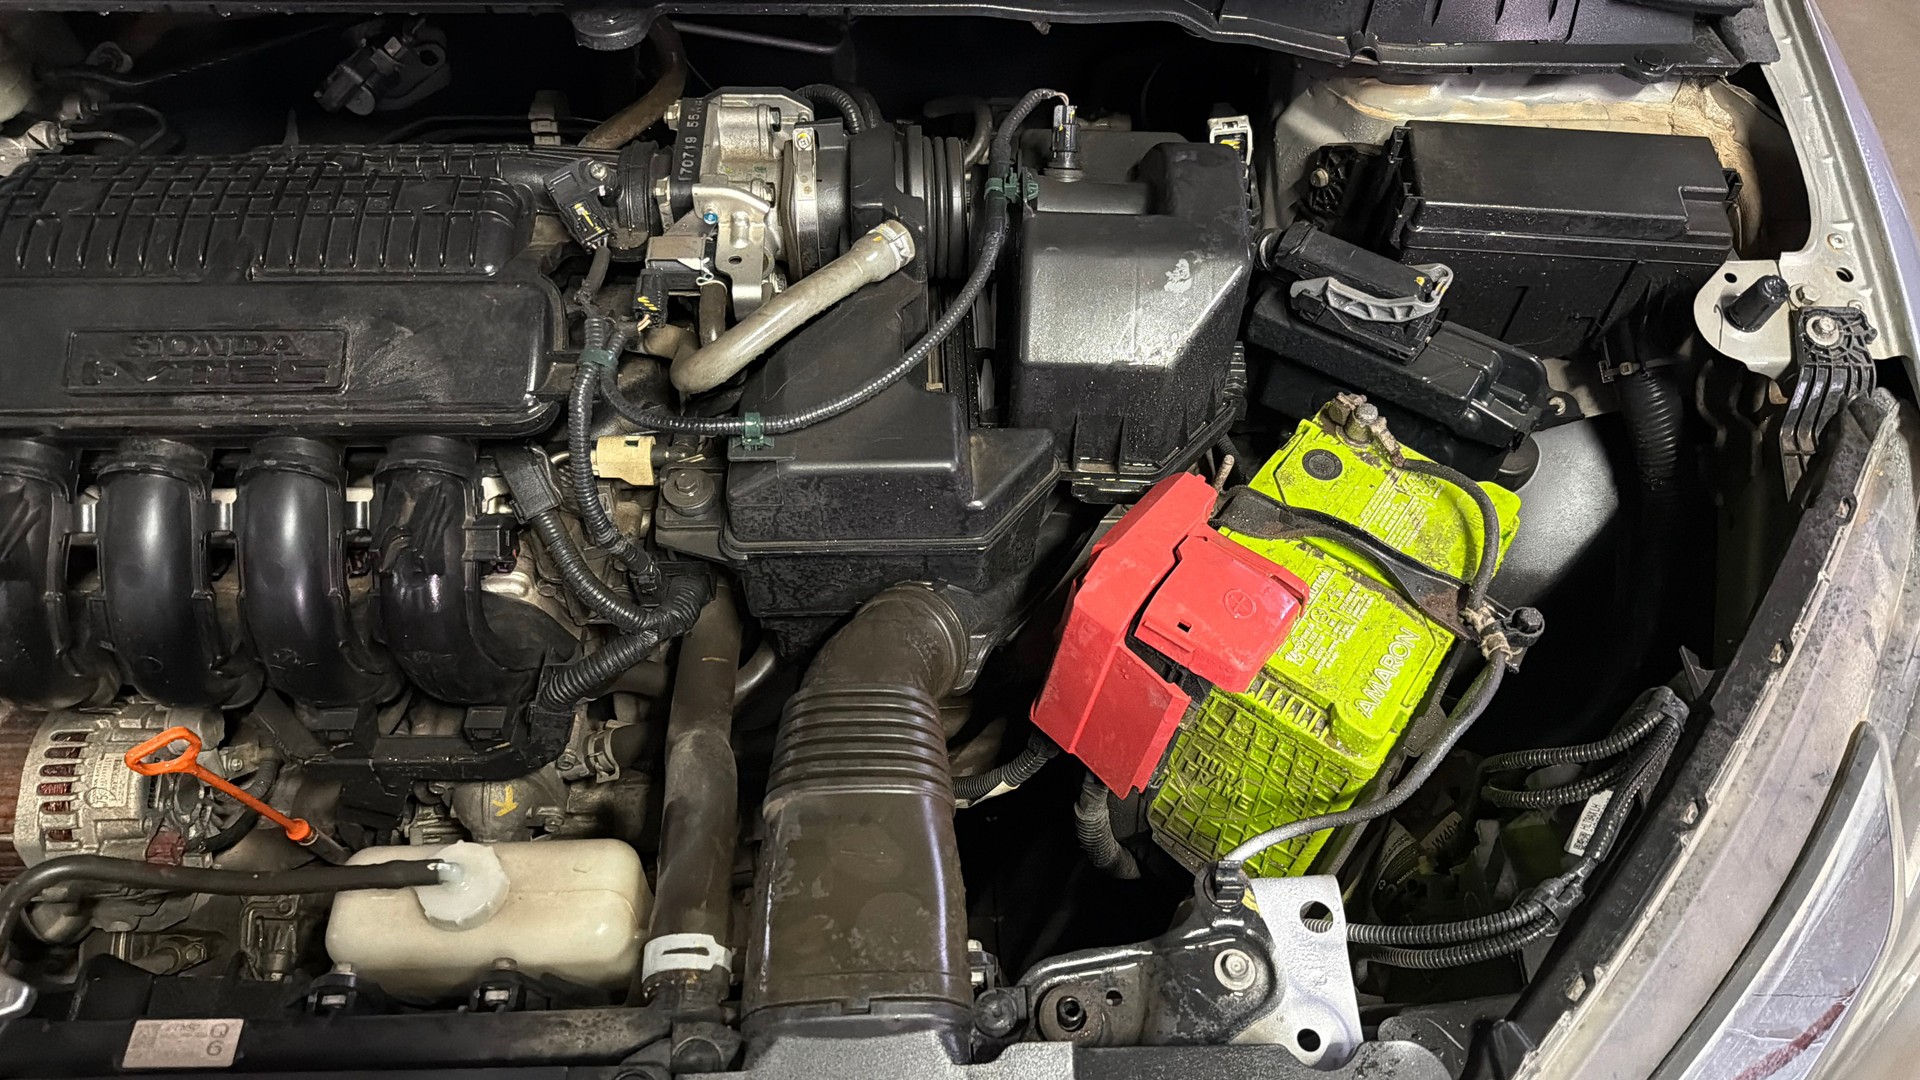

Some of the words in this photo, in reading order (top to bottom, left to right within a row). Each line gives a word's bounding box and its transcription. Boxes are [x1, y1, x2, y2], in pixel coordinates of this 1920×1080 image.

[125, 335, 305, 358] HONDA
[1354, 626, 1421, 720] AMARON
[1182, 758, 1256, 812] FRAME
[1196, 751, 1247, 795] DURA
[206, 1040, 224, 1057] 6
